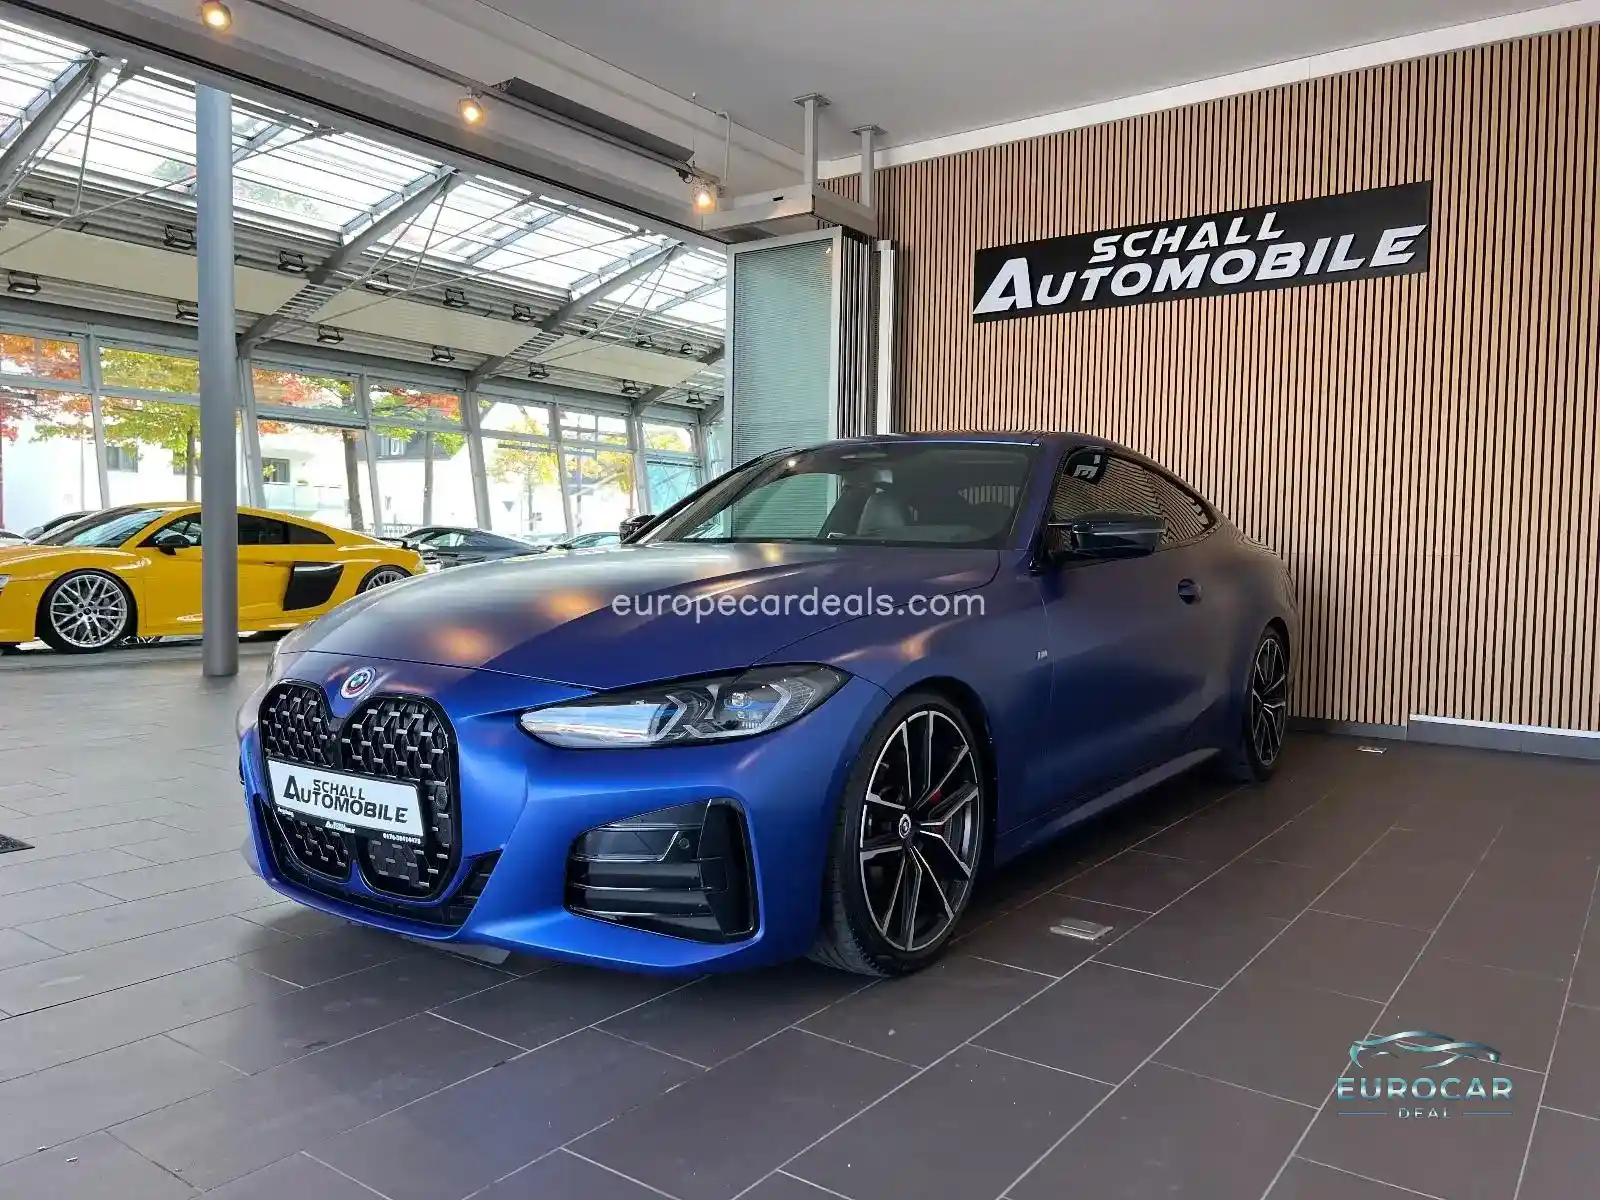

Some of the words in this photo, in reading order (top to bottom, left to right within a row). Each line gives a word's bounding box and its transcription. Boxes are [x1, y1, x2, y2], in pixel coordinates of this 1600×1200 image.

[1088, 211, 1285, 264] SCHALL
[973, 223, 1428, 315] AUTOMOBILE
[282, 774, 409, 824] AUTOMOBILE
[313, 778, 366, 801] SCHALL
